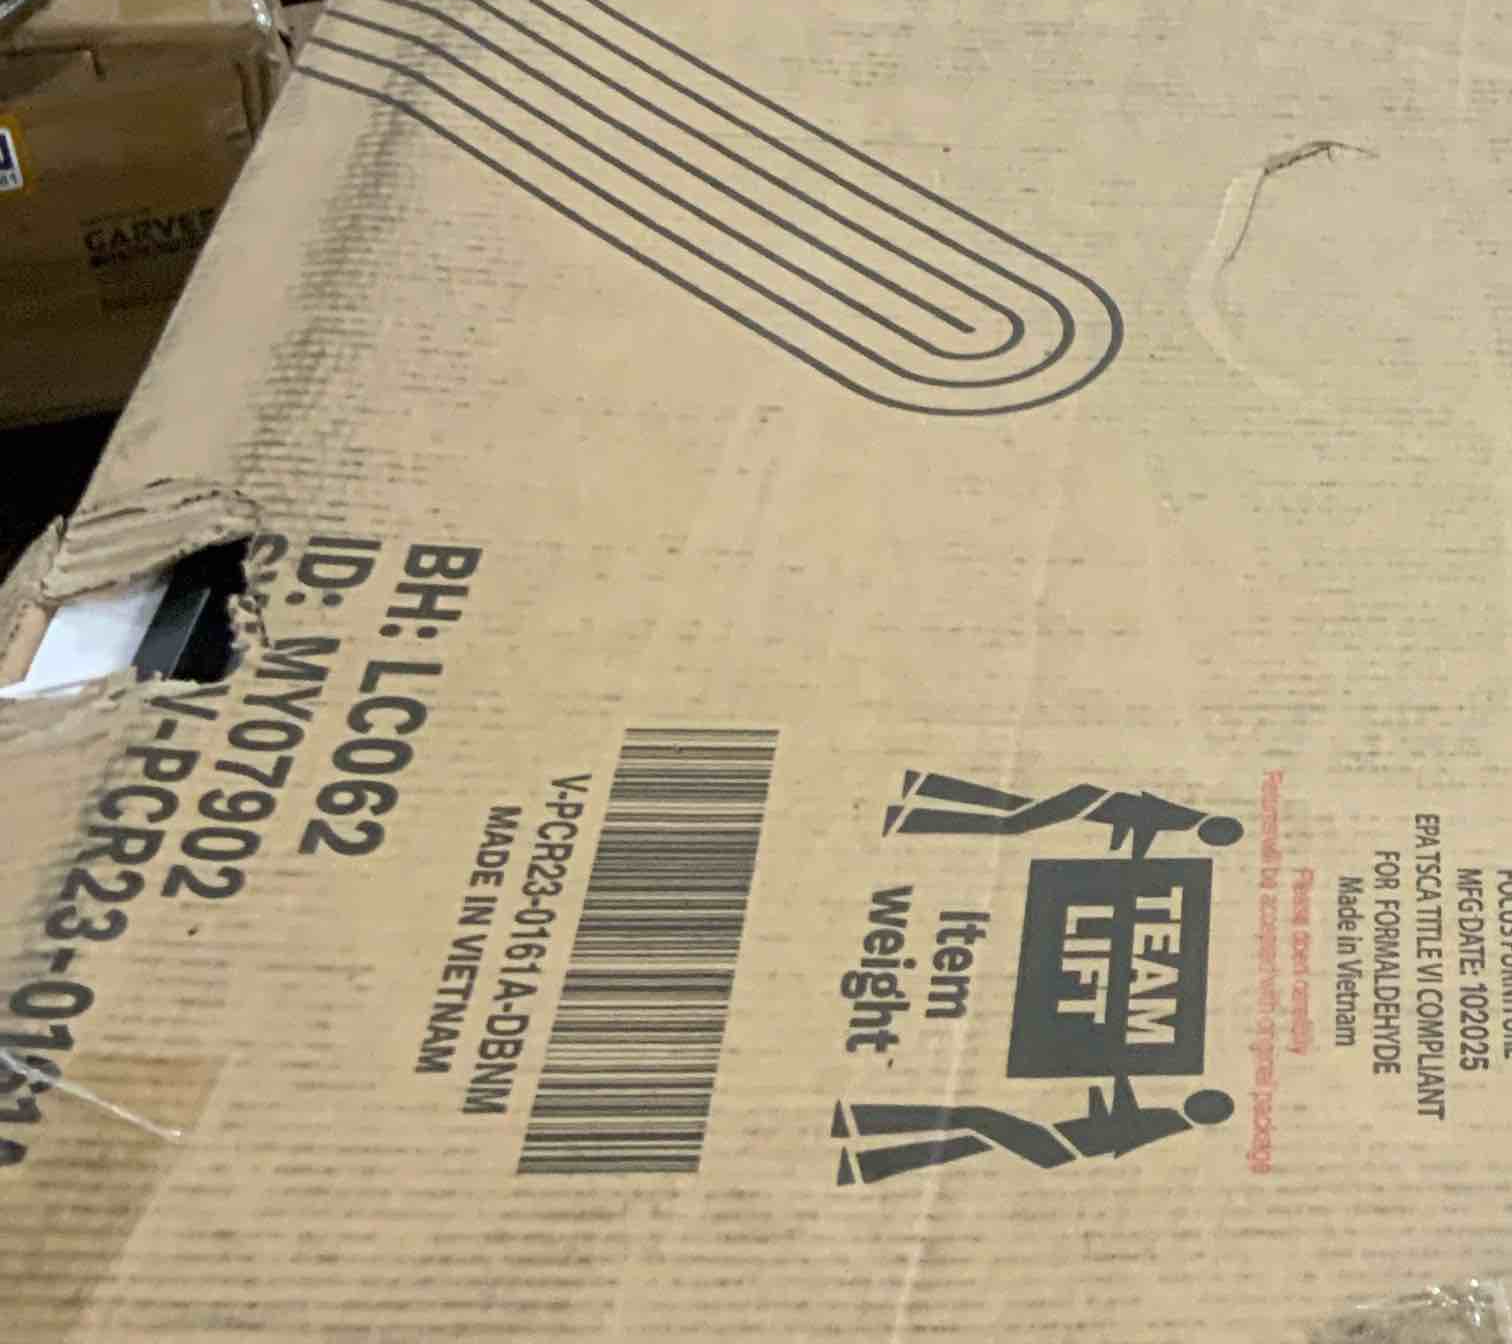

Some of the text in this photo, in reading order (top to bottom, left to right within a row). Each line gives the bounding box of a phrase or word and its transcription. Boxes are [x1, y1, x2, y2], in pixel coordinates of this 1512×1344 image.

[160, 536, 382, 899] ID: MY07902
[299, 544, 483, 856] BH: LC062
[413, 806, 522, 1074] MADE IN VIETNAM
[461, 773, 592, 1115] V-PCR23-0161A-DBNM
[840, 885, 914, 1054] weight
[925, 911, 991, 1018] Item
[1056, 905, 1115, 1025] LIFT
[1124, 886, 1185, 1046] TEAM
[1334, 876, 1365, 1047] Made in Vietnam
[1372, 850, 1401, 1075] FOR FORMALDEHYDE
[1415, 813, 1446, 1121] EPA TSCA TITLE VI COMPLIANT
[1456, 868, 1490, 1071] MFG DATE: 102025
